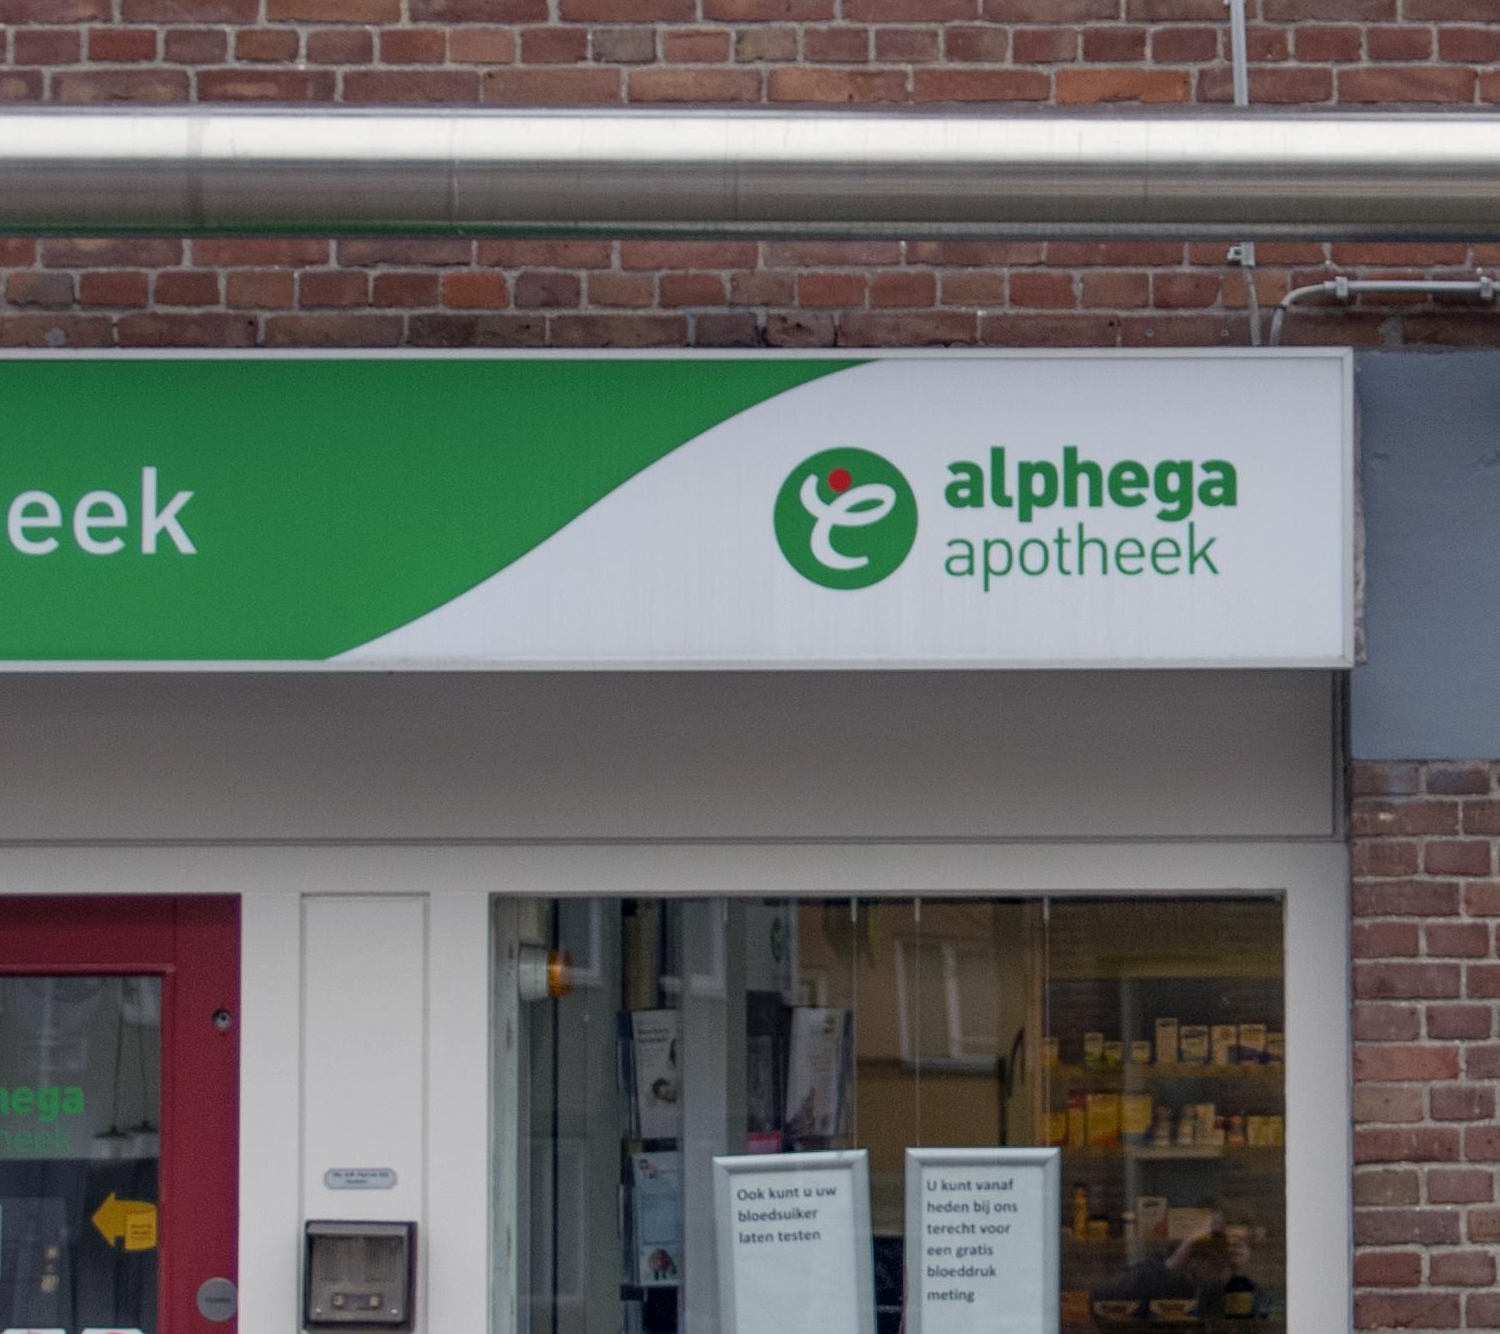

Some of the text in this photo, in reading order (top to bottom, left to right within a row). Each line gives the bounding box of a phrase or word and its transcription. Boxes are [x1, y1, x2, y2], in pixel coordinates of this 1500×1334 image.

[944, 446, 1238, 522] alphega
[945, 522, 1220, 592] apotheek
[927, 1179, 1014, 1192] U kunt vanaf
[737, 1186, 837, 1201] Ook kunt u uw
[738, 1207, 818, 1223] bloedsuiker
[927, 1201, 1018, 1215] heden bij ons
[927, 1223, 1010, 1234] terecht voor
[739, 1229, 821, 1244] laten testen
[927, 1244, 994, 1259] een gratis
[927, 1265, 997, 1278] bloeddruk
[927, 1289, 975, 1303] meting
